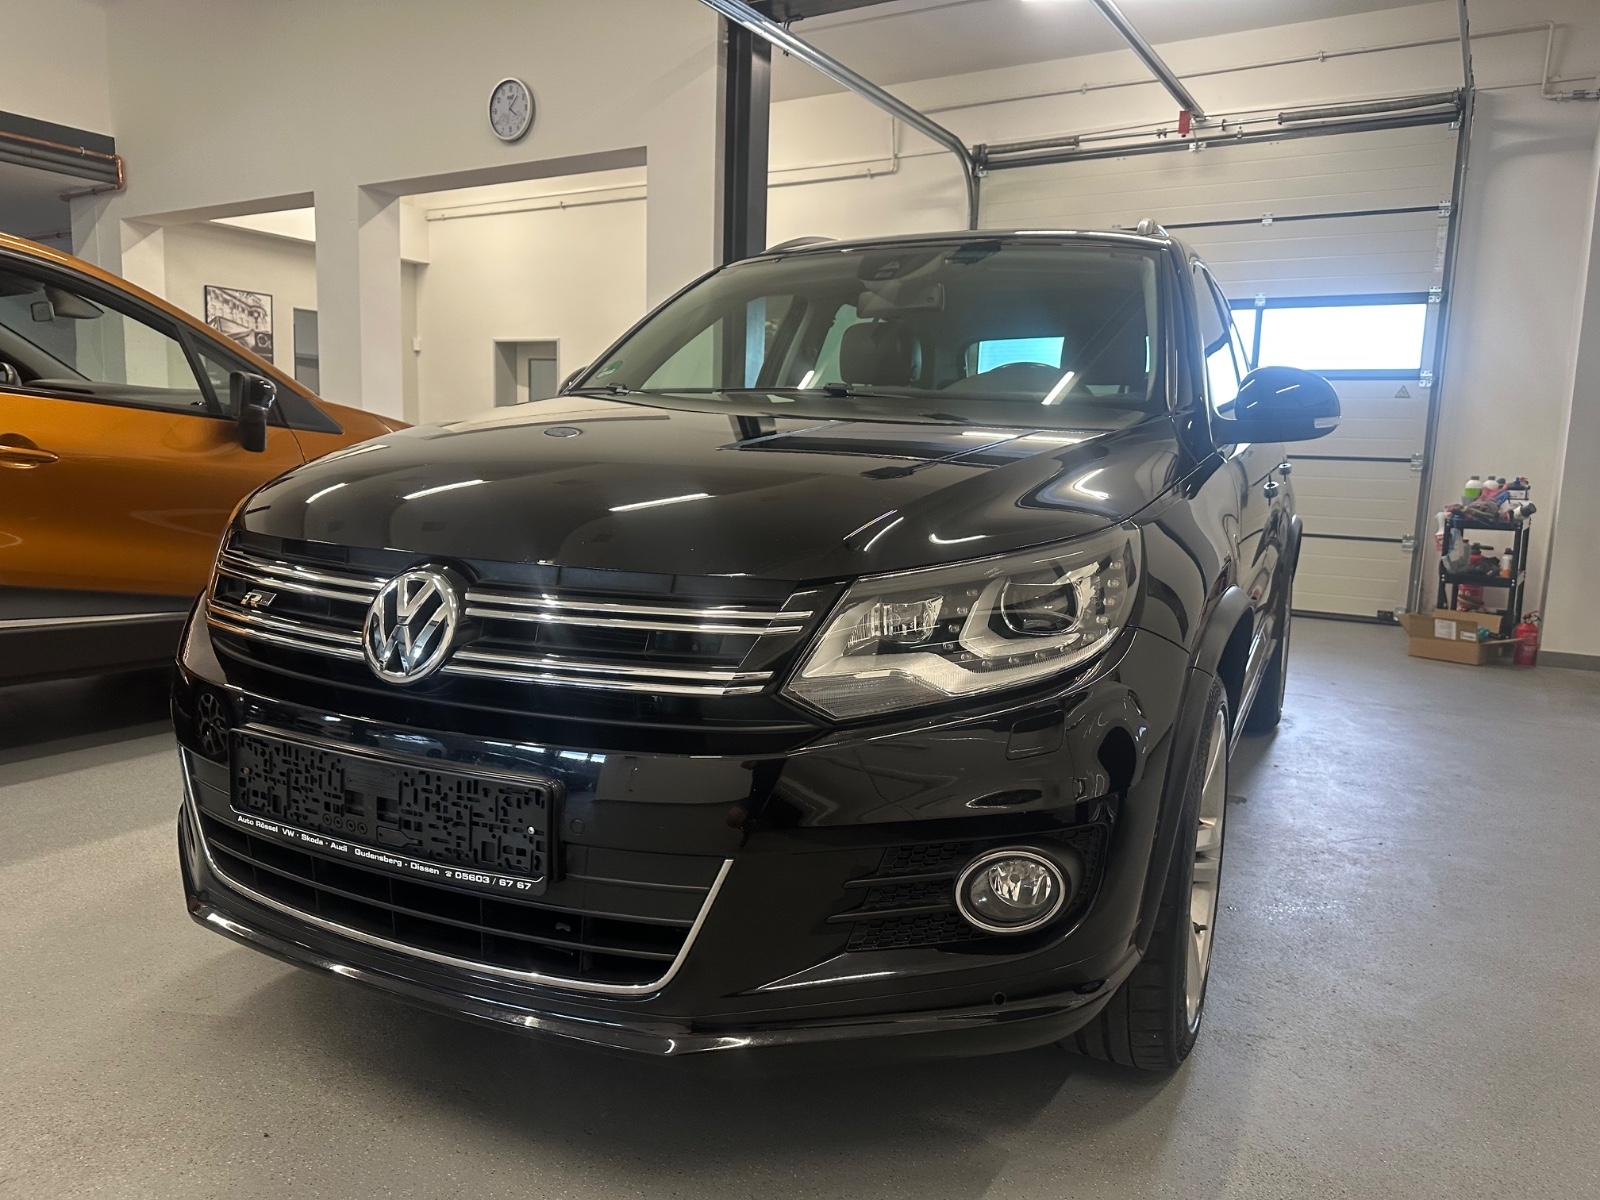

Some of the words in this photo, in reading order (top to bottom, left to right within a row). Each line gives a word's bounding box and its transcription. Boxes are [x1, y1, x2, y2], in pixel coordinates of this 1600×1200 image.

[238, 815, 254, 825] Auto
[255, 820, 278, 832] Rössel
[282, 828, 295, 837] VW
[301, 833, 323, 845] Skoda
[330, 842, 348, 852] Audi
[410, 861, 440, 875] Dissen
[455, 871, 490, 884] 05603
[499, 879, 514, 887] 67
[516, 881, 532, 890] 67
